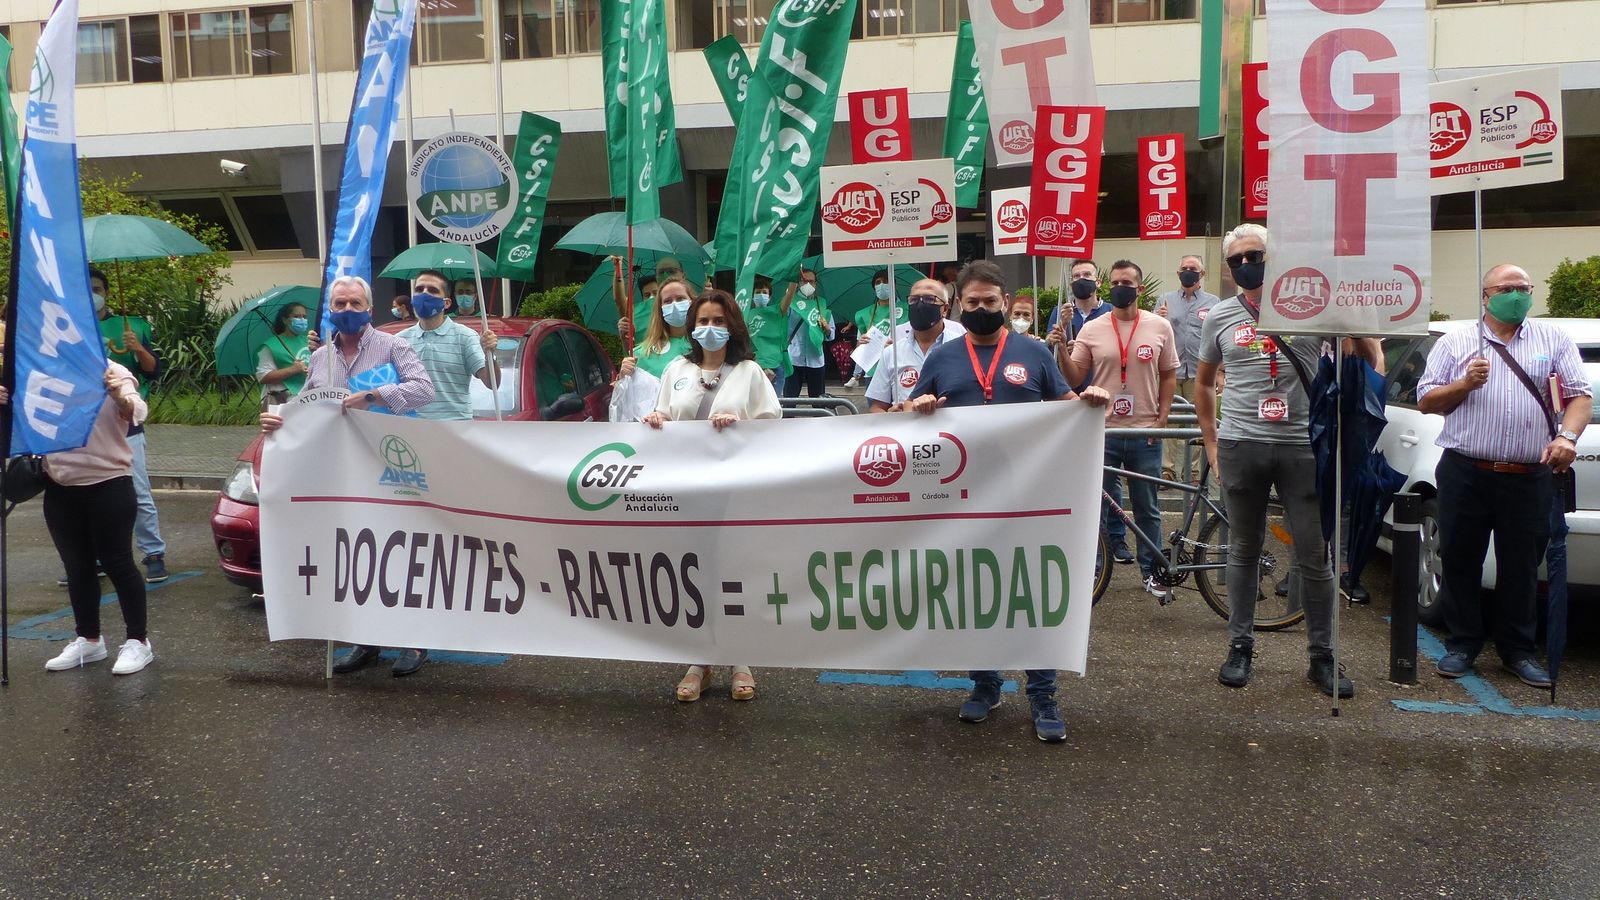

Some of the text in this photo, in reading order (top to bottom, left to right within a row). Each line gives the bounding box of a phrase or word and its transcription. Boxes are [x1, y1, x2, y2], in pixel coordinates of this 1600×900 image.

[26, 100, 59, 129] PE
[1430, 109, 1462, 132] GT
[862, 96, 901, 158] UG
[1003, 125, 1031, 141] UGT
[1480, 123, 1518, 134] Servicios
[1480, 134, 1516, 144] Públicos
[410, 135, 512, 178] SINDICATO INDEPENDIENTE
[1045, 113, 1091, 215] UGT
[1148, 139, 1177, 210] UGT
[430, 191, 499, 216] ANPE
[838, 190, 878, 210] UGT
[823, 204, 840, 214] UGT
[891, 207, 921, 215] Servicios
[933, 204, 950, 214] UGT
[1001, 205, 1025, 219] UGT
[891, 215, 919, 223] Públicos
[438, 223, 500, 242] ANDALUCÍA
[1039, 221, 1058, 231] UGT
[1279, 276, 1324, 297] UGT
[1336, 279, 1403, 292] Andalucía
[1336, 292, 1403, 307] CÓRDOBA
[1234, 327, 1252, 338] UGT
[902, 370, 916, 379] UGT
[1006, 365, 1025, 377] UGT
[1264, 401, 1283, 410] UGT
[860, 443, 899, 465] UGT
[912, 461, 941, 469] Servicios
[378, 466, 429, 489] ANPE
[581, 463, 645, 488] CSIF
[912, 468, 939, 476] Públicos
[624, 493, 673, 502] Educación
[865, 495, 899, 503] Andalucía
[921, 492, 950, 500] Córdoba
[625, 502, 679, 512] Andalucía
[334, 527, 526, 615] DOCENTES
[557, 547, 705, 629] RATIOS
[807, 544, 1070, 632] SEGURIDAD
